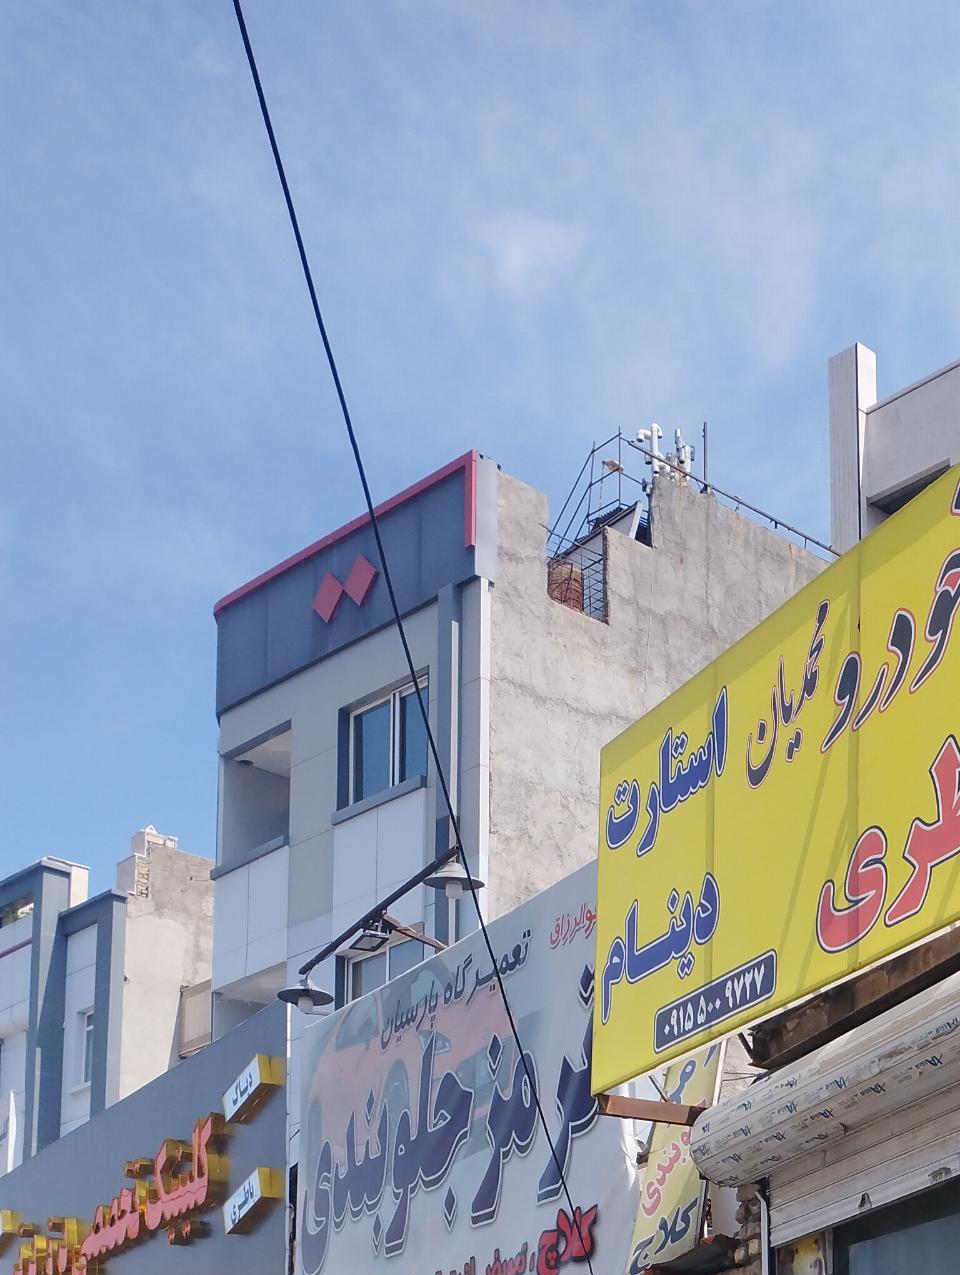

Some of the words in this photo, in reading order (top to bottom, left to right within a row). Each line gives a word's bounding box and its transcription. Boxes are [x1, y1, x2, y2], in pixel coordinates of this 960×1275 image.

[606, 685, 729, 858] استارت
[443, 928, 533, 1007] تعمیرگاه
[600, 873, 720, 1026] دینام
[380, 979, 438, 1052] پارسیان
[663, 1001, 694, 1036] ۰۹۱۵
[697, 995, 721, 1024] ۵۰۰
[725, 963, 765, 1008] ۹۷۲۷
[146, 1115, 213, 1244] کلینیک
[629, 1197, 699, 1275] کلاچ
